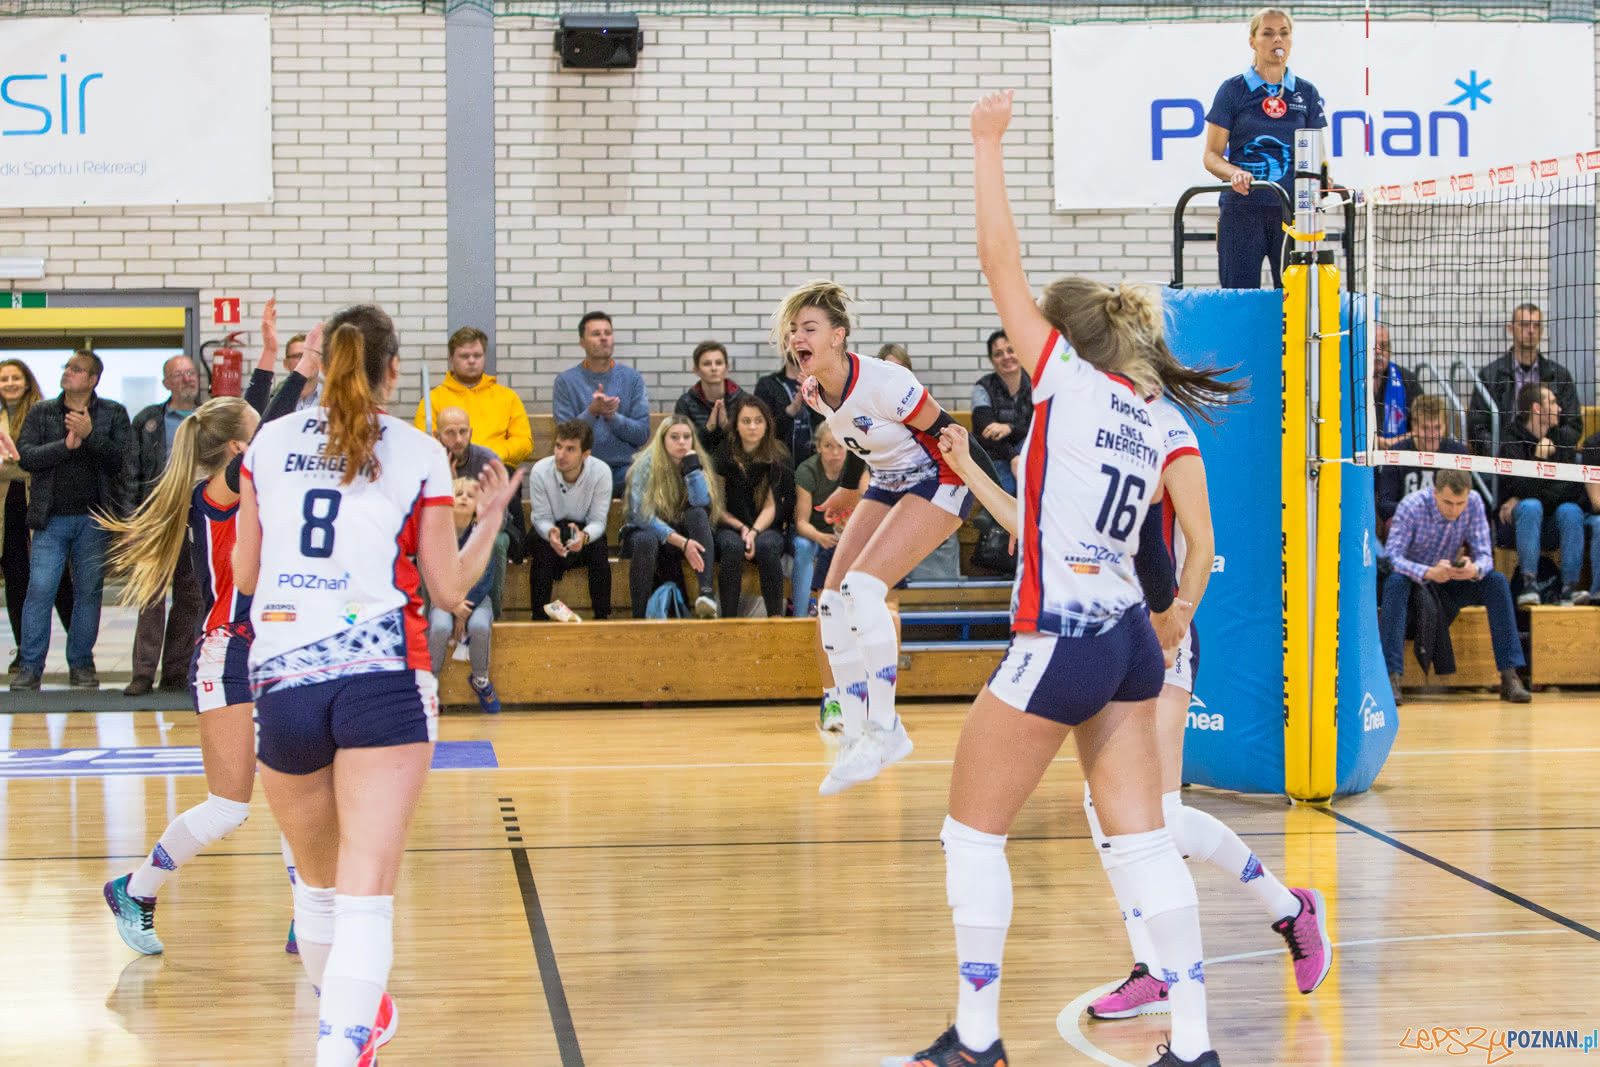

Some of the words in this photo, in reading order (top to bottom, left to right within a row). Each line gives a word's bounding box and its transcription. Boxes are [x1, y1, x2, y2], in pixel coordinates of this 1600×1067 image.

[23, 160, 72, 178] Sportu
[83, 160, 147, 176] Rekreacji
[1120, 423, 1145, 443] ENEA
[1095, 463, 1146, 542] 16
[300, 488, 342, 558] 8
[1185, 712, 1223, 732] nea
[1364, 708, 1385, 732] Enea
